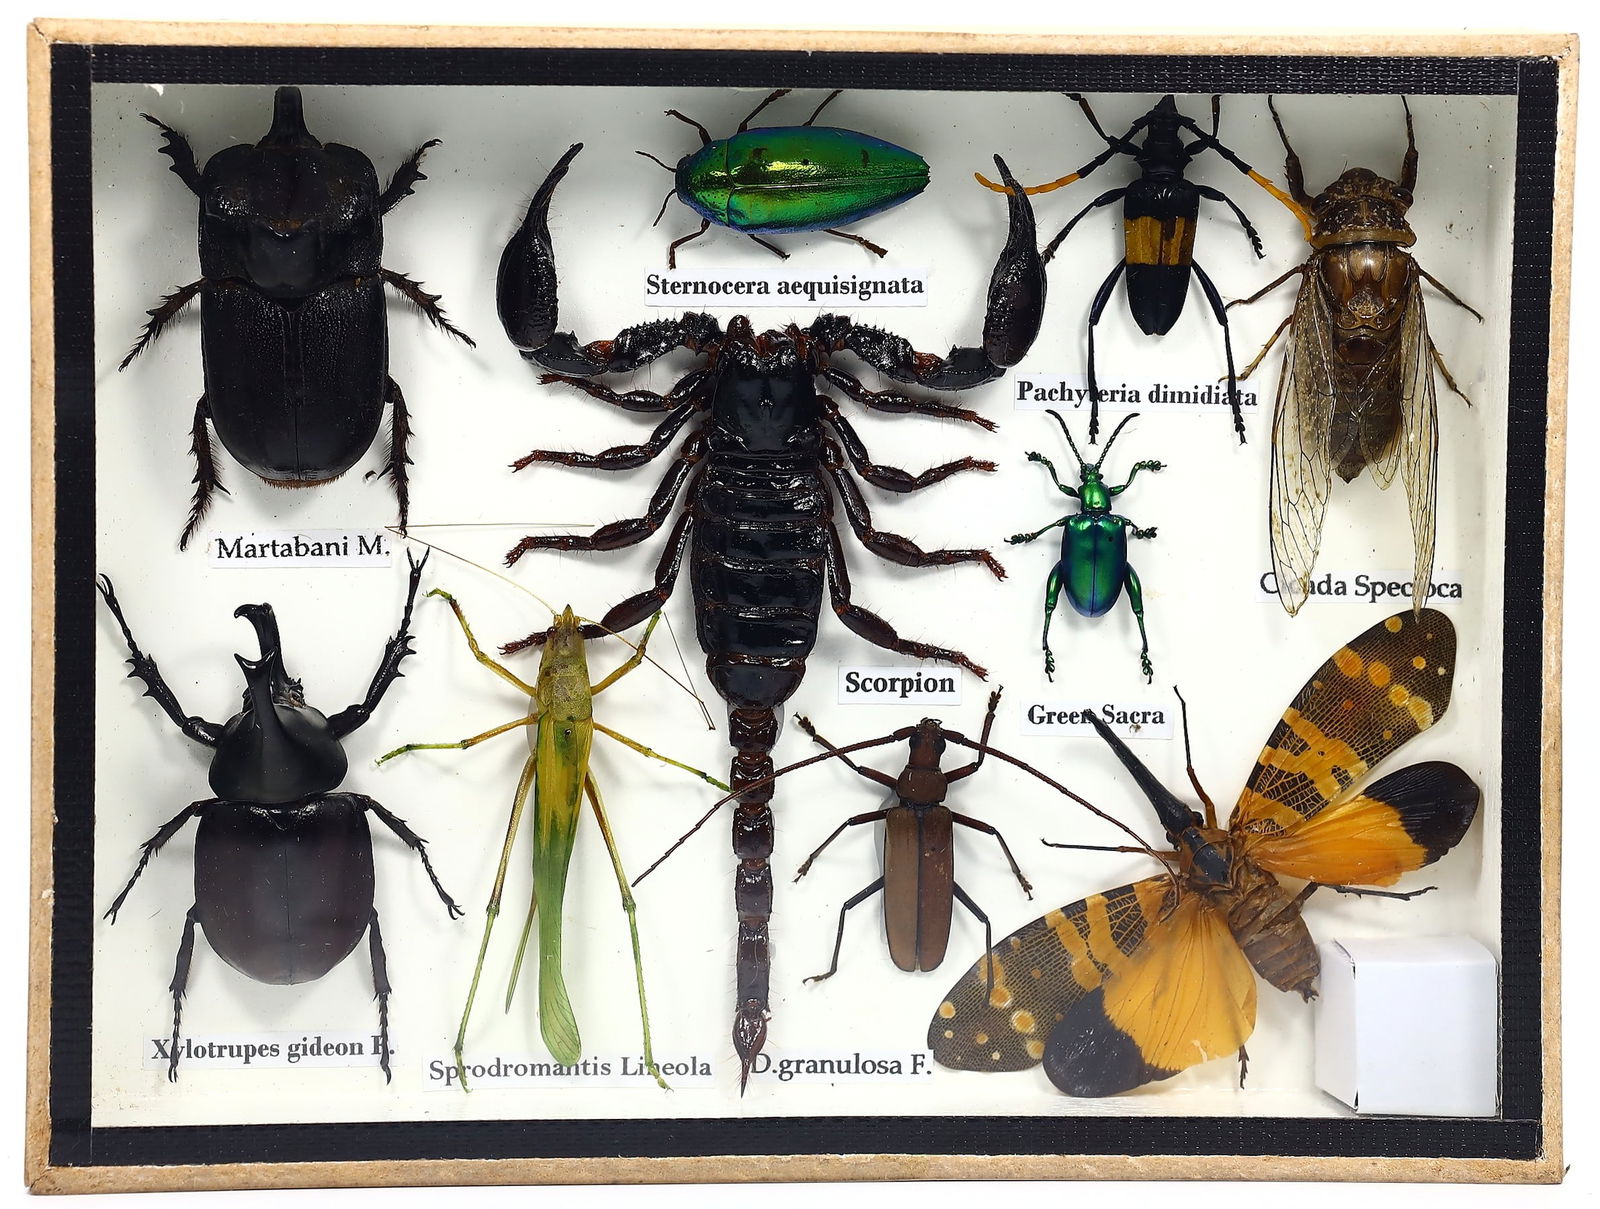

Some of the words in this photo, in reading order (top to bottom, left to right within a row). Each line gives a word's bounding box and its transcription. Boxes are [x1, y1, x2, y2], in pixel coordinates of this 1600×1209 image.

[646, 274, 770, 295] Sternocera
[777, 275, 924, 301] aequisignata
[1017, 380, 1141, 408] Pachyeria
[1148, 384, 1257, 406] dimidiata
[215, 535, 349, 559] Martabani
[357, 535, 391, 556] M.
[1354, 575, 1462, 603] Specoca
[845, 671, 956, 698] Scorpion
[1102, 704, 1165, 725] Sacra
[287, 1036, 364, 1063] gideon
[429, 1056, 611, 1086] Sprodromantis
[621, 1055, 712, 1077] Lineola
[751, 1053, 902, 1082] D.granulosa
[910, 1053, 932, 1075] F.
